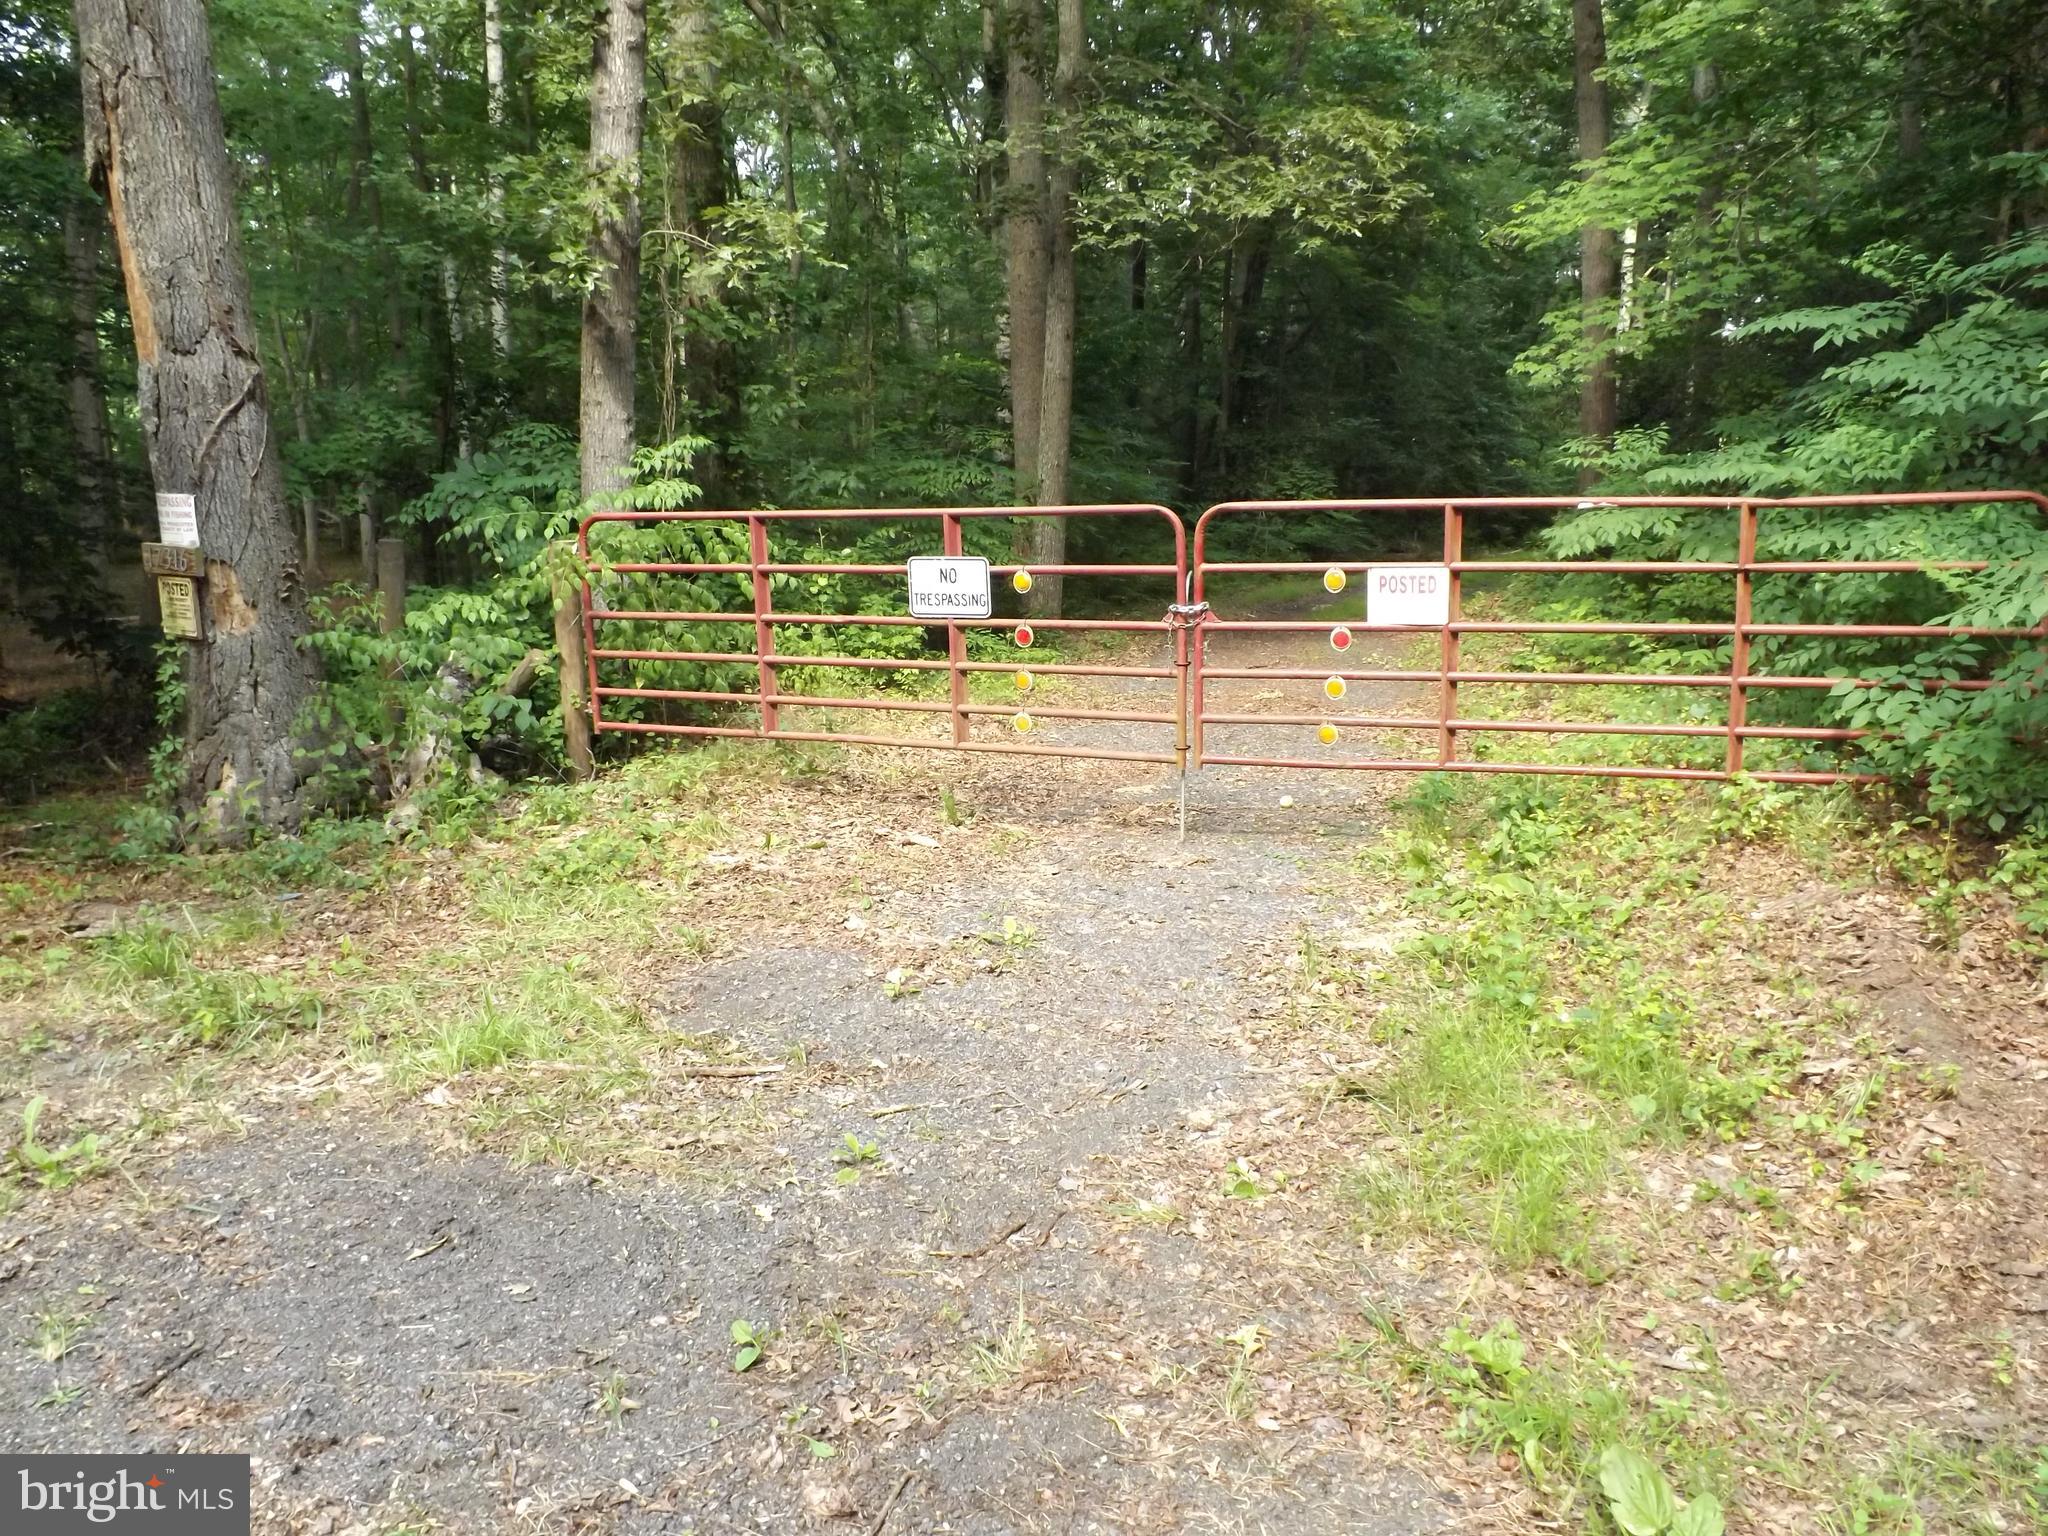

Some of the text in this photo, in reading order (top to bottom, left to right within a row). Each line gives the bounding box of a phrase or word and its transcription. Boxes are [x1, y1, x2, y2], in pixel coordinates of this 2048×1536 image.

[939, 567, 957, 584] NO
[162, 582, 190, 597] POSTED
[1379, 575, 1437, 594] POSTED
[914, 592, 986, 607] TRESPASSING
